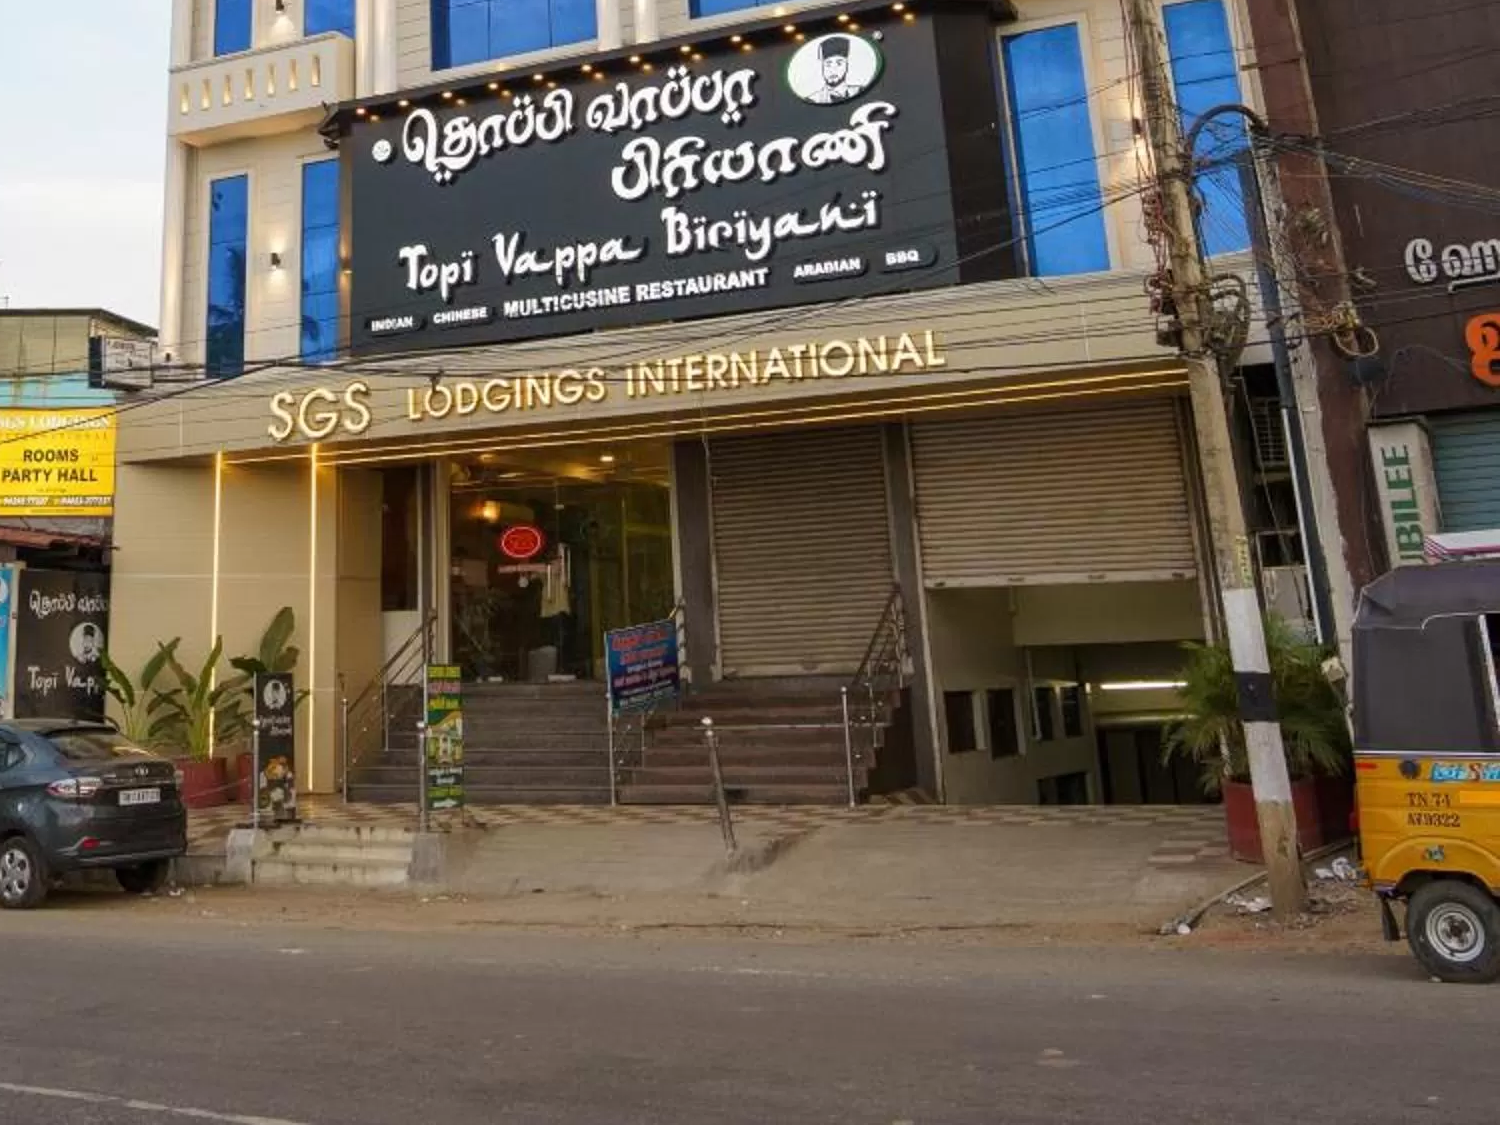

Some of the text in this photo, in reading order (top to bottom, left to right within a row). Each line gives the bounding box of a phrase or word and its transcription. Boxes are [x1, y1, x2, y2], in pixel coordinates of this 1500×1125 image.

[610, 101, 897, 200] பிரியாணி
[492, 231, 644, 286] Vappa
[371, 249, 920, 332] INDIAN CHINESE MULTICUSINE RESTAURANT ARABIAN BBQ
[268, 330, 946, 441] SGS LODGINGS INTERNATIONAL
[1, 467, 99, 483] PARTY HALL
[23, 448, 79, 463] ROOMS
[1407, 792, 1429, 807] TN
